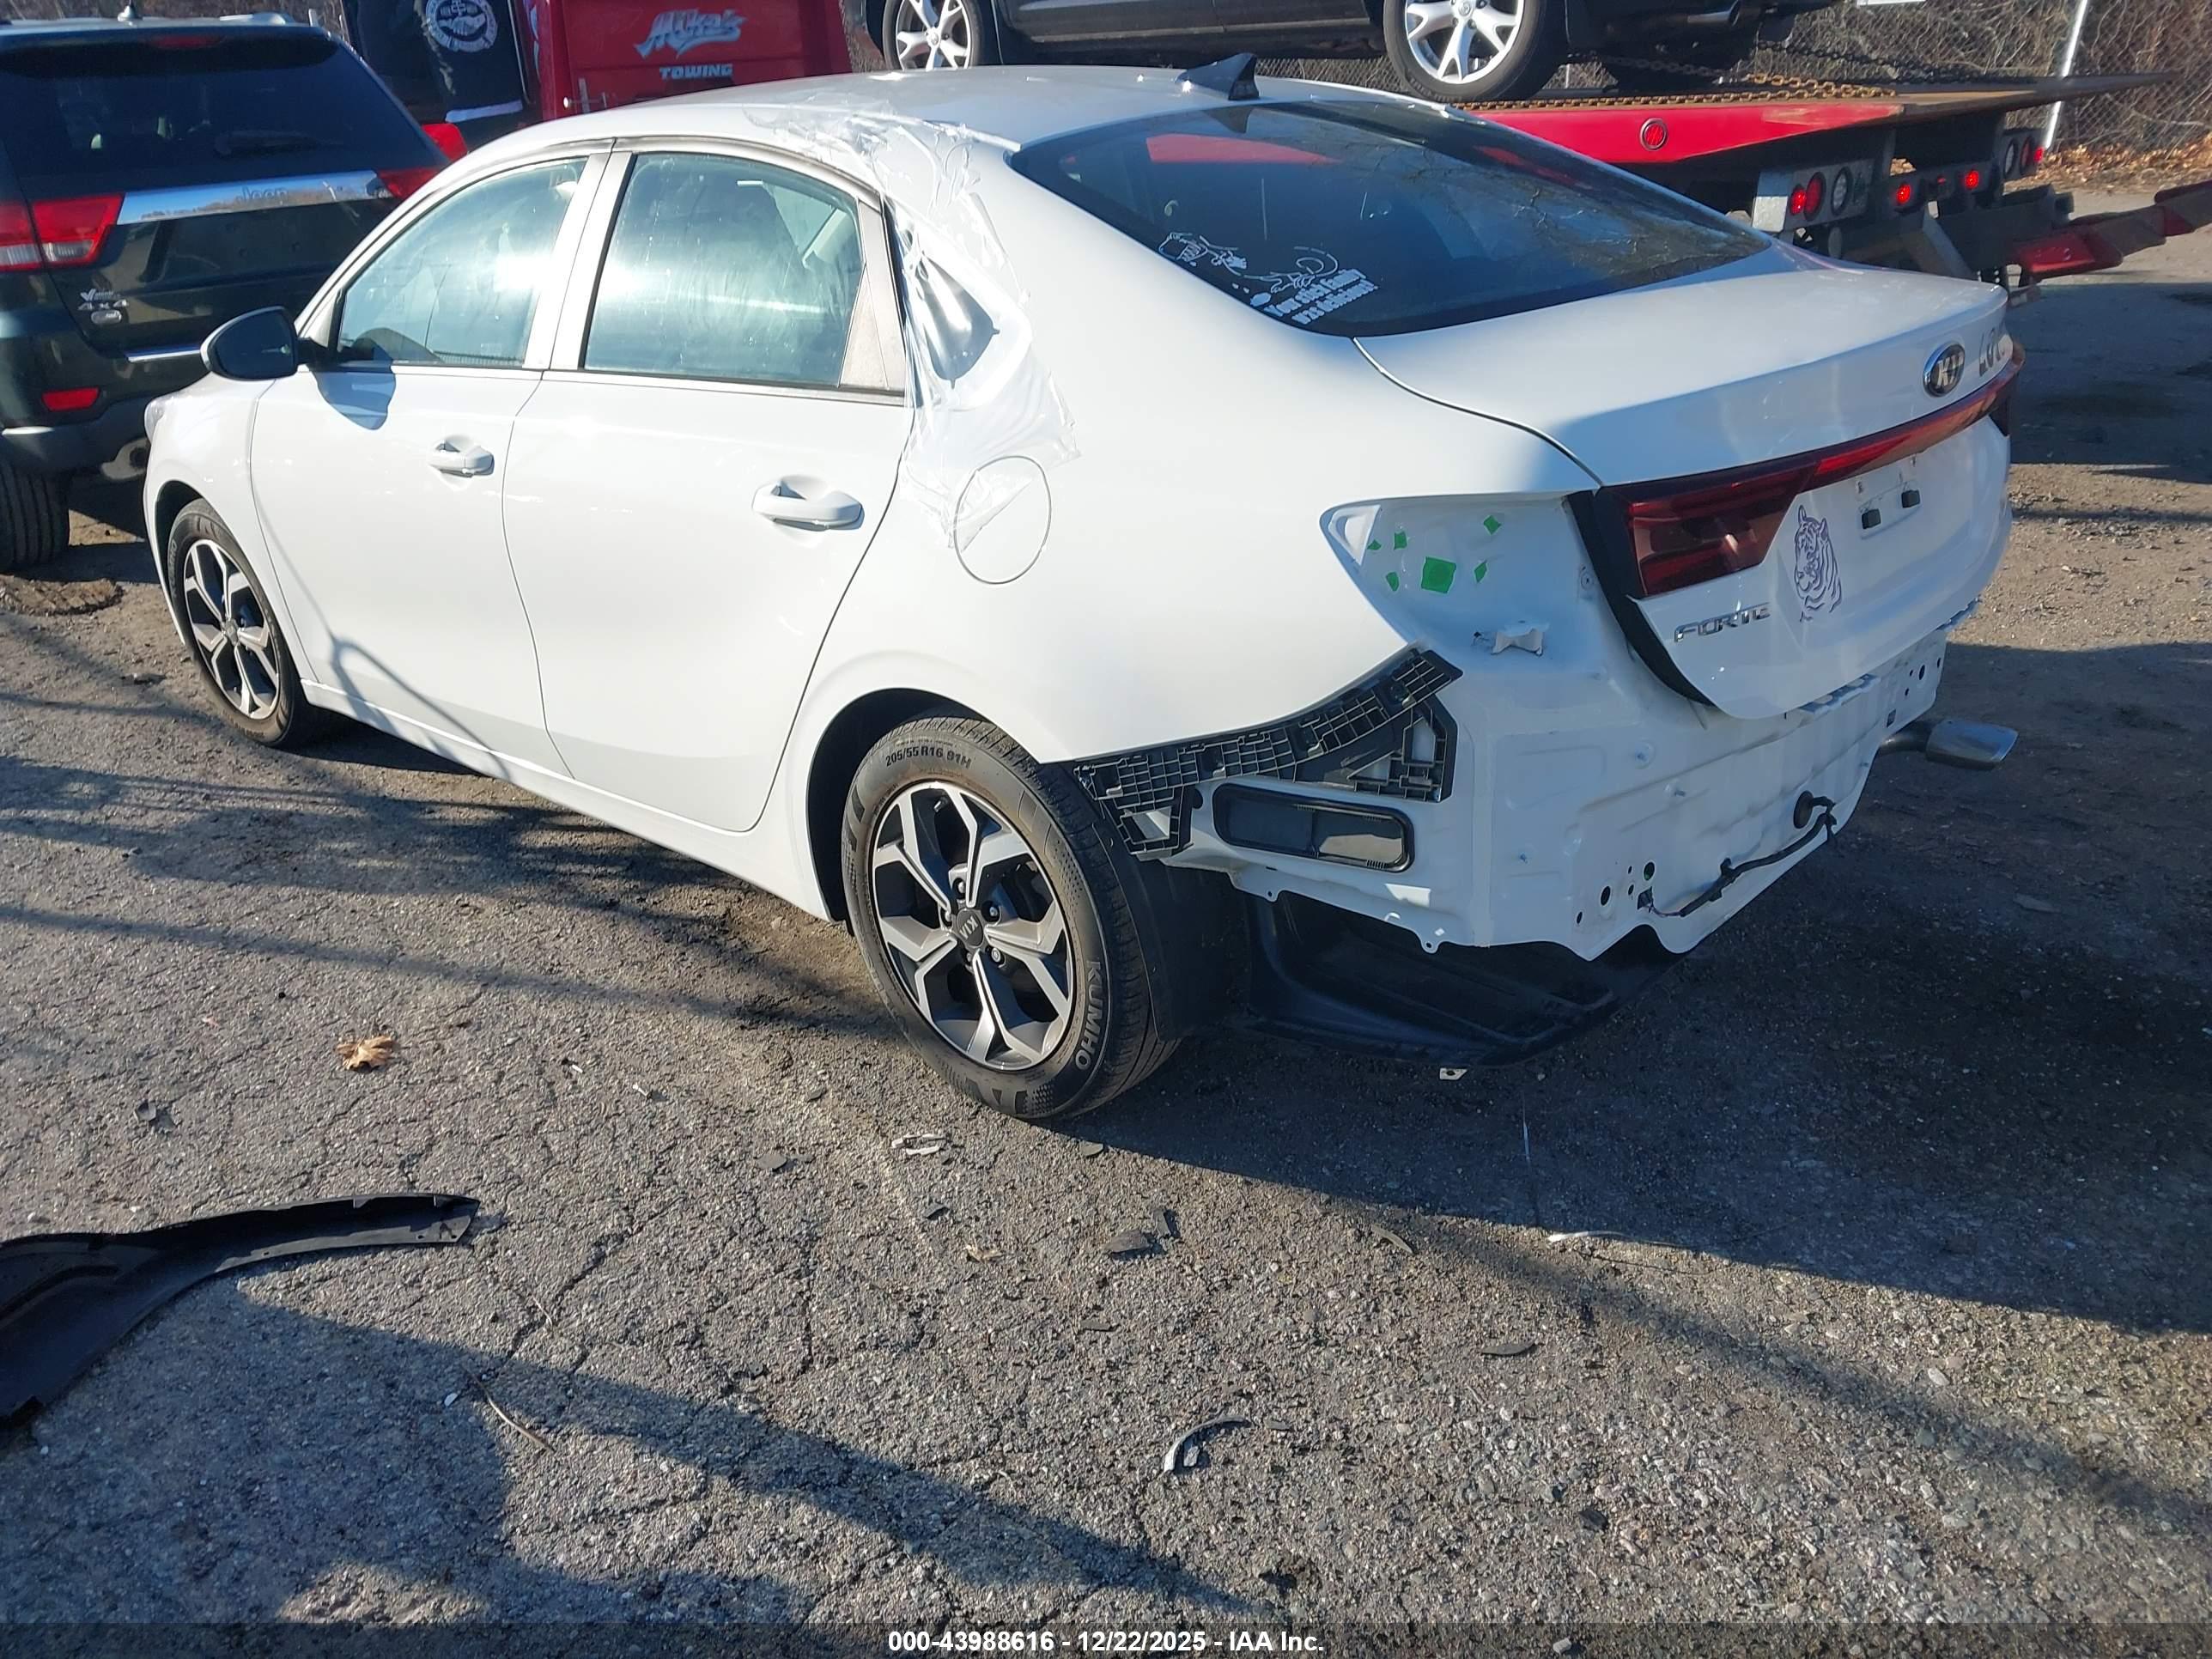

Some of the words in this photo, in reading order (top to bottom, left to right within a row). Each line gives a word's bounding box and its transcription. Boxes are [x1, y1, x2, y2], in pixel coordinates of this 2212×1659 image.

[659, 64, 732, 80] TOWING
[234, 186, 288, 204] Jeep
[1674, 601, 1771, 642] FORTE
[946, 750, 972, 769] 91H
[959, 915, 979, 940] KIA
[1075, 960, 1104, 1070] KUMHO
